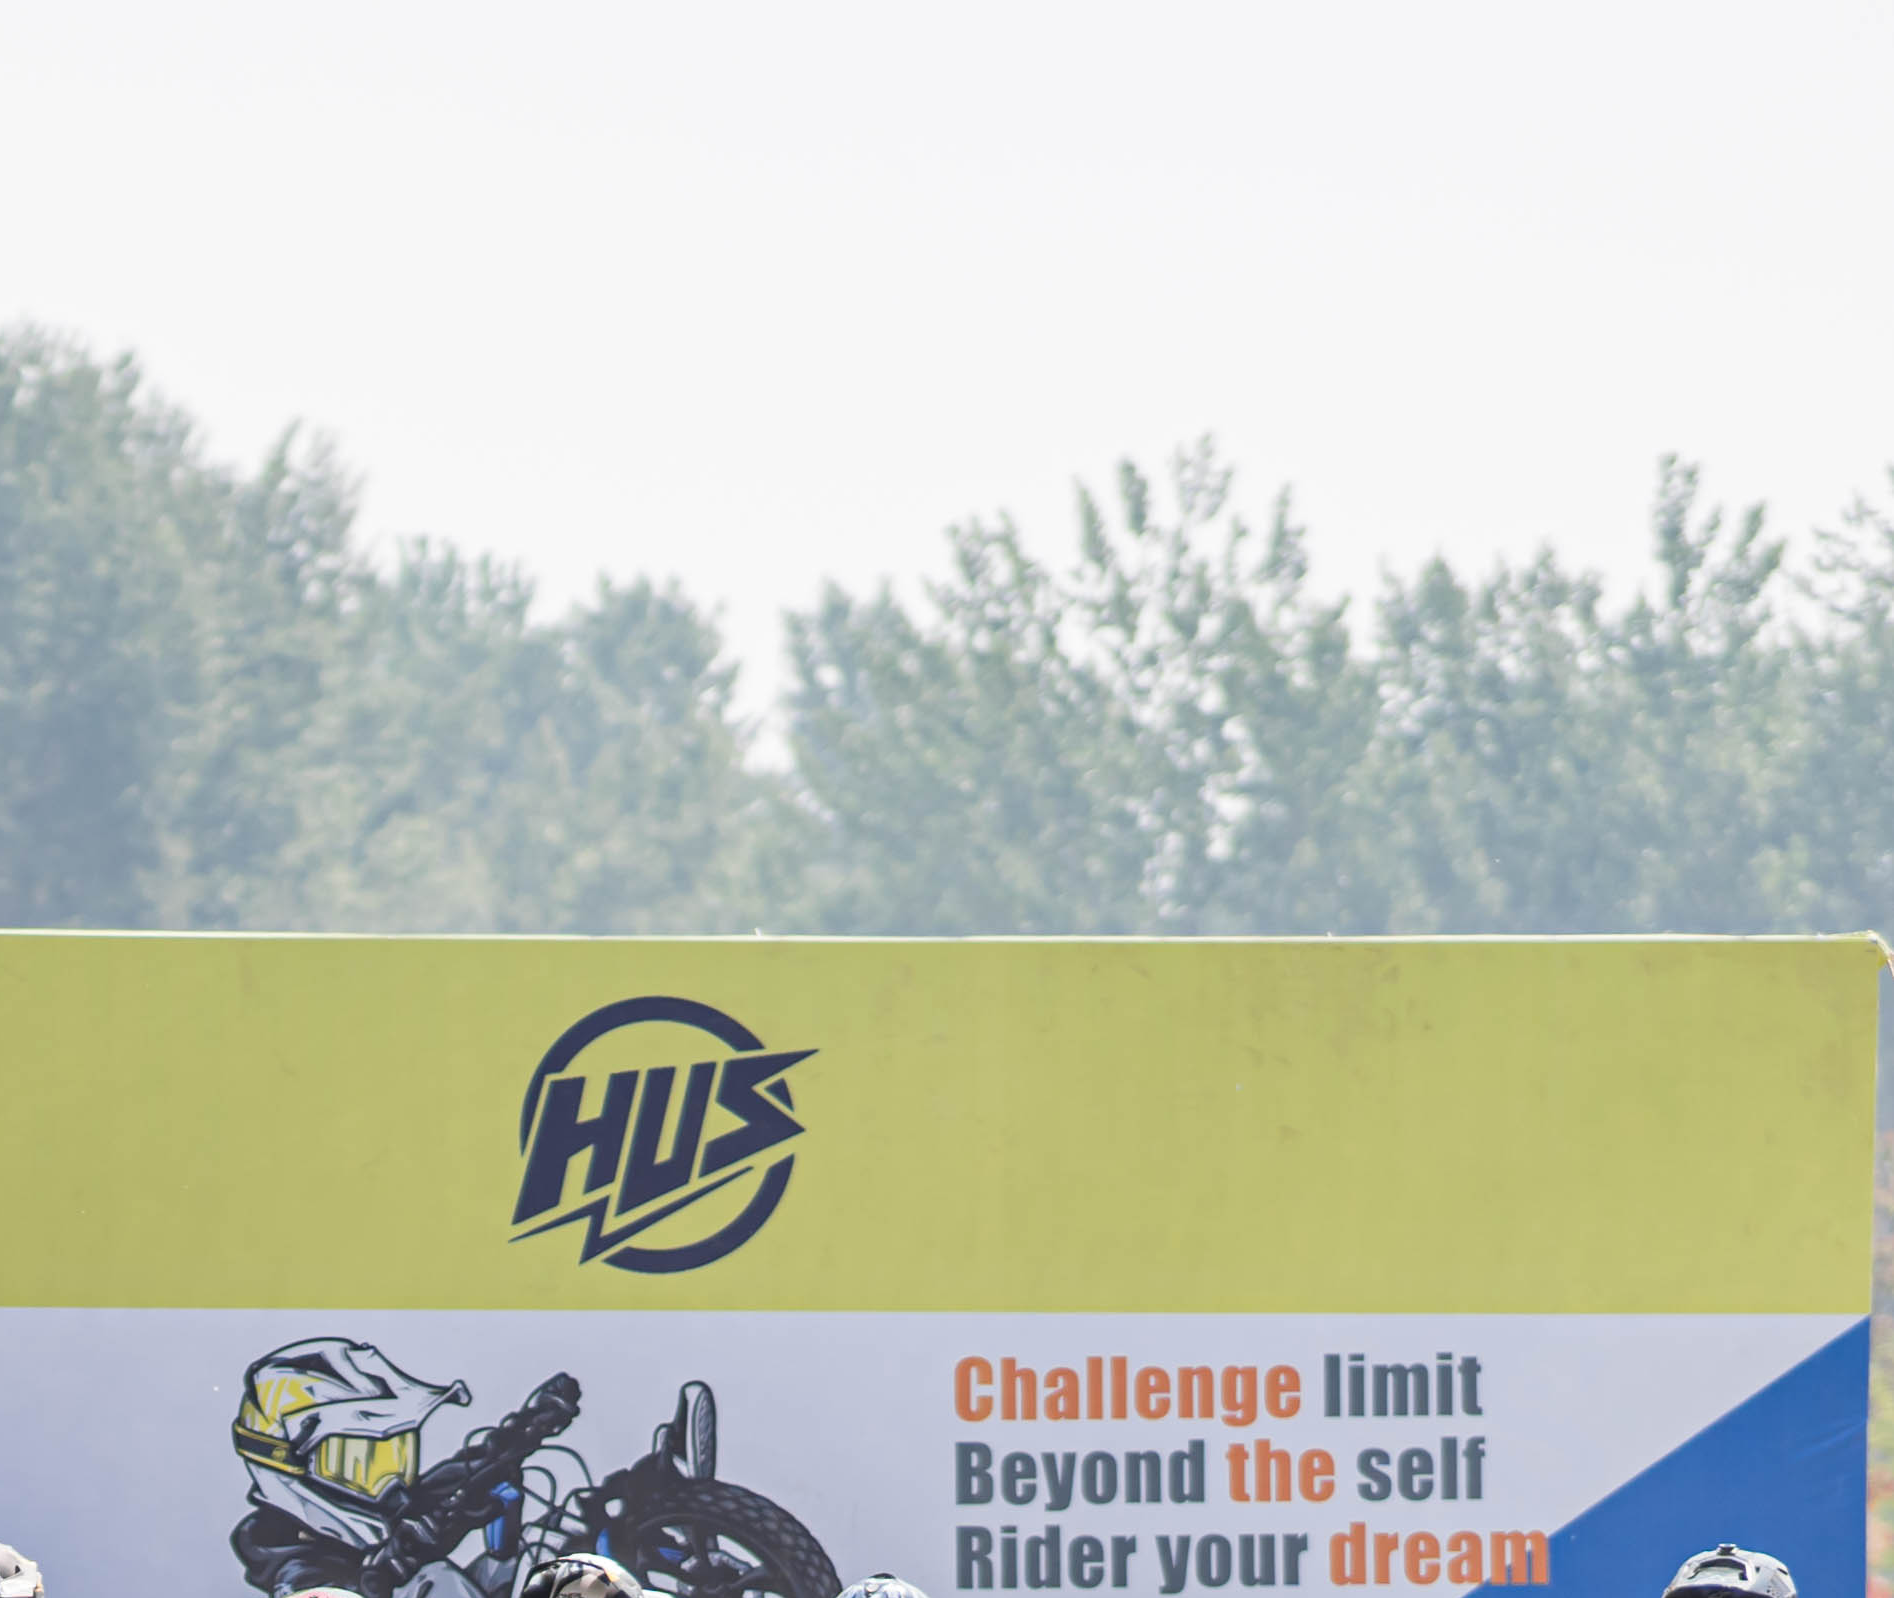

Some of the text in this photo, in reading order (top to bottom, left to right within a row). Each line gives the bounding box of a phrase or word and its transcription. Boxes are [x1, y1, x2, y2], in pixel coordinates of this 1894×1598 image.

[510, 1046, 821, 1230] HUS
[952, 1351, 1484, 1428] Challenge limit
[954, 1435, 1487, 1513] Beyond the self
[955, 1521, 1551, 1595] Rider your dream
